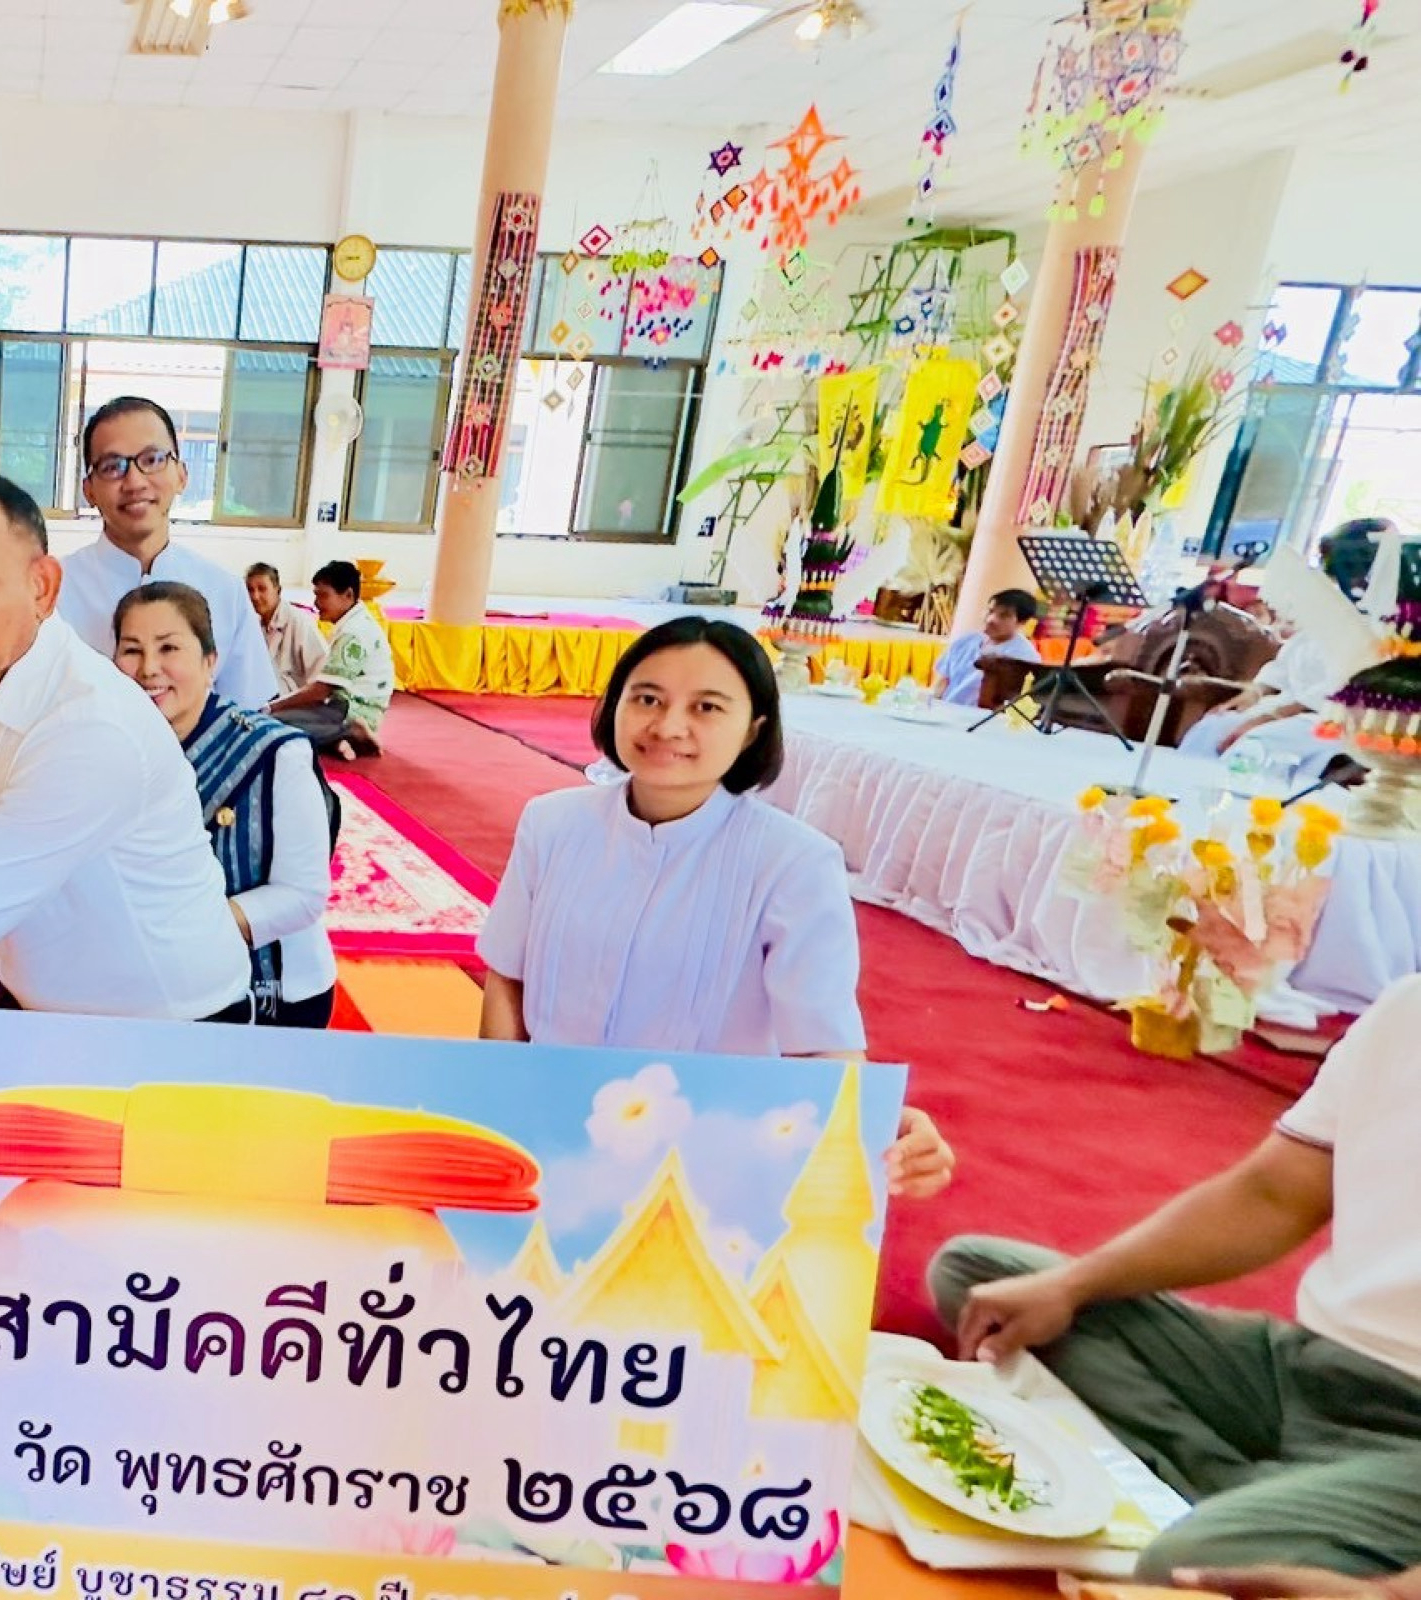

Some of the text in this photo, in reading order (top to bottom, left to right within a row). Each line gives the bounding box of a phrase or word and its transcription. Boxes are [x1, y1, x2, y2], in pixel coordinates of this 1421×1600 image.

[13, 1419, 92, 1487] วัด
[114, 1439, 470, 1517] พุทธศักราช
[502, 1456, 813, 1542] ๒๕๖๘
